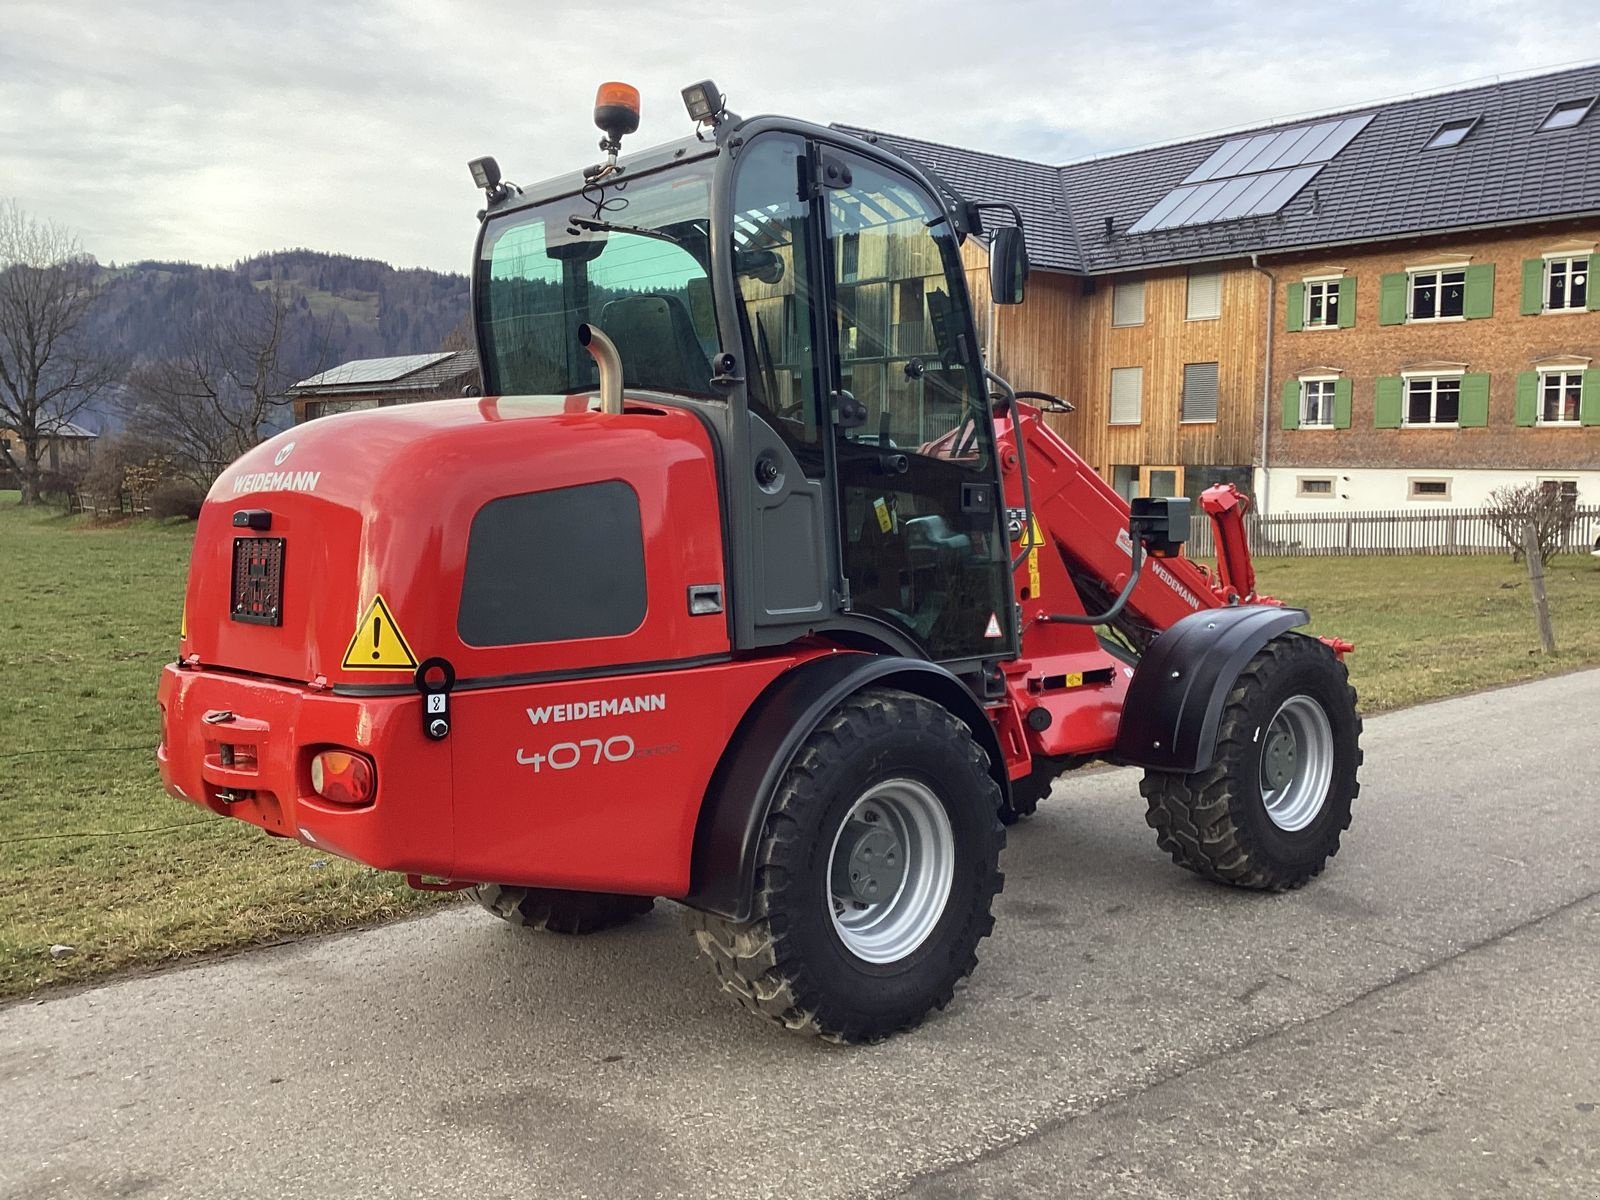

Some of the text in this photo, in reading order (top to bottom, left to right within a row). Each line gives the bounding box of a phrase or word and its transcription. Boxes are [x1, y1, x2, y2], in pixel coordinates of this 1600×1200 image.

[232, 471, 321, 493] WEIDEMANN
[1152, 560, 1200, 610] WEIDEMANN
[526, 693, 666, 725] WEIDEMANN
[516, 734, 635, 773] 4070
